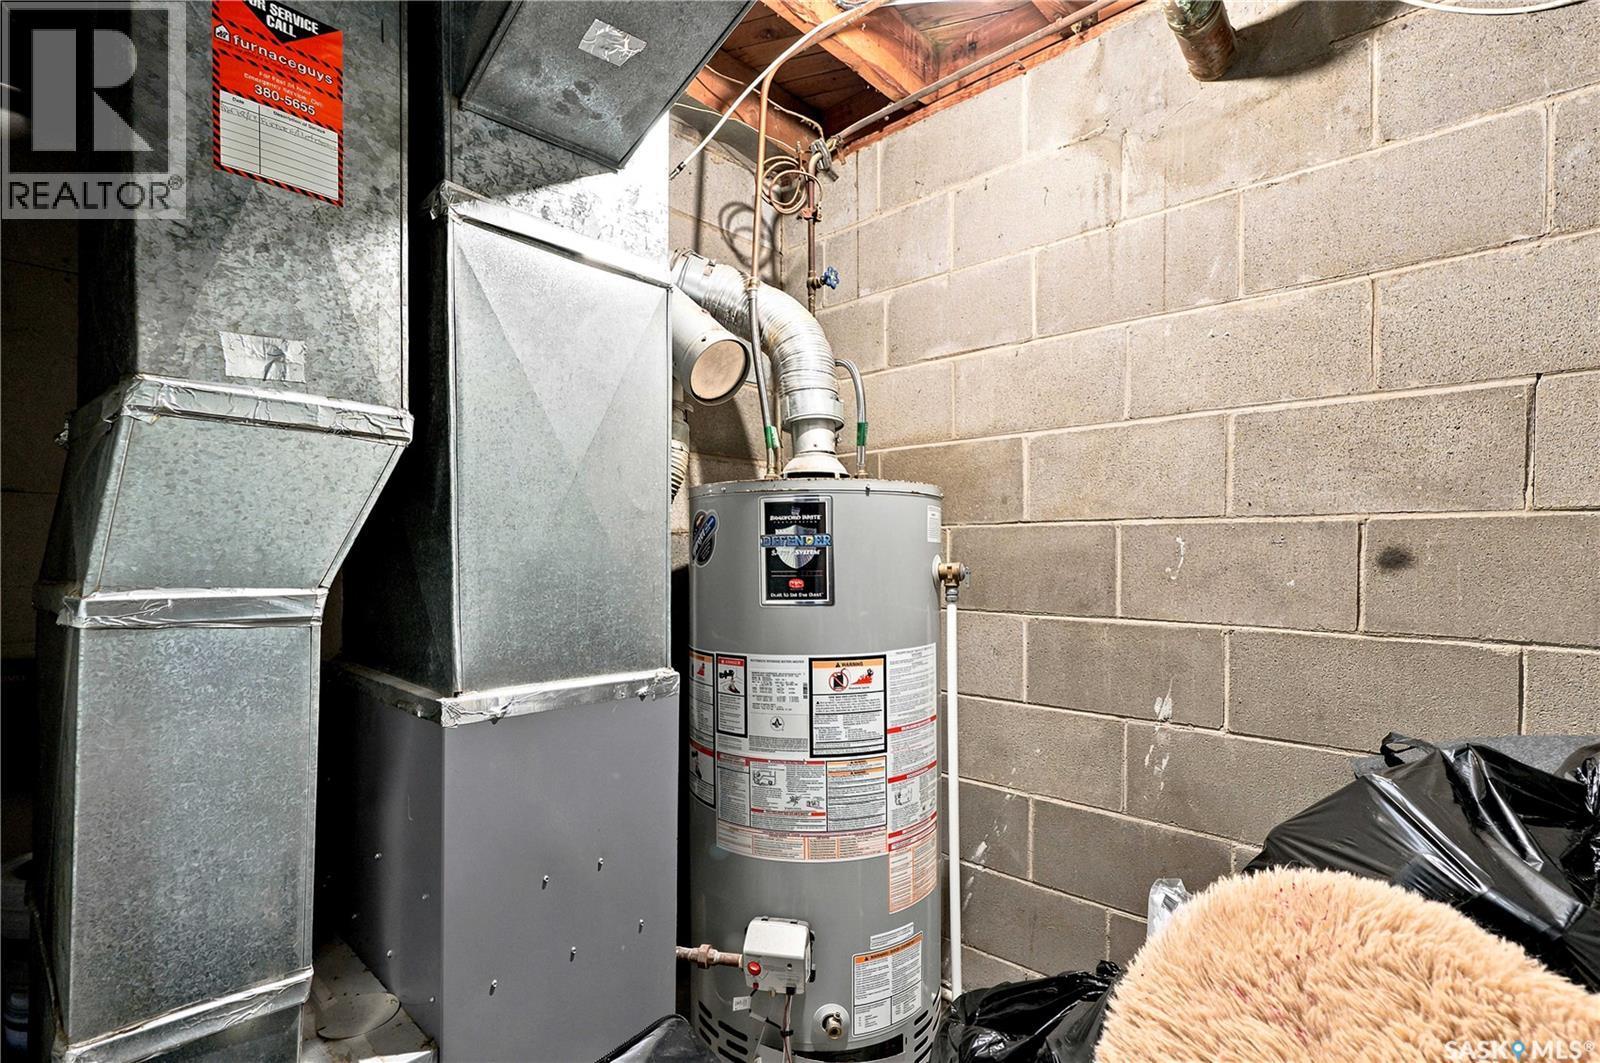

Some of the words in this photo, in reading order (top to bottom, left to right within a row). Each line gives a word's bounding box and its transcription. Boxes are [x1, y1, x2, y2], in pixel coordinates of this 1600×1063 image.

[266, 14, 297, 38] CALL
[269, 3, 319, 35] SERVICE
[233, 34, 333, 84] furnaceguys
[254, 84, 316, 116] 380-5655
